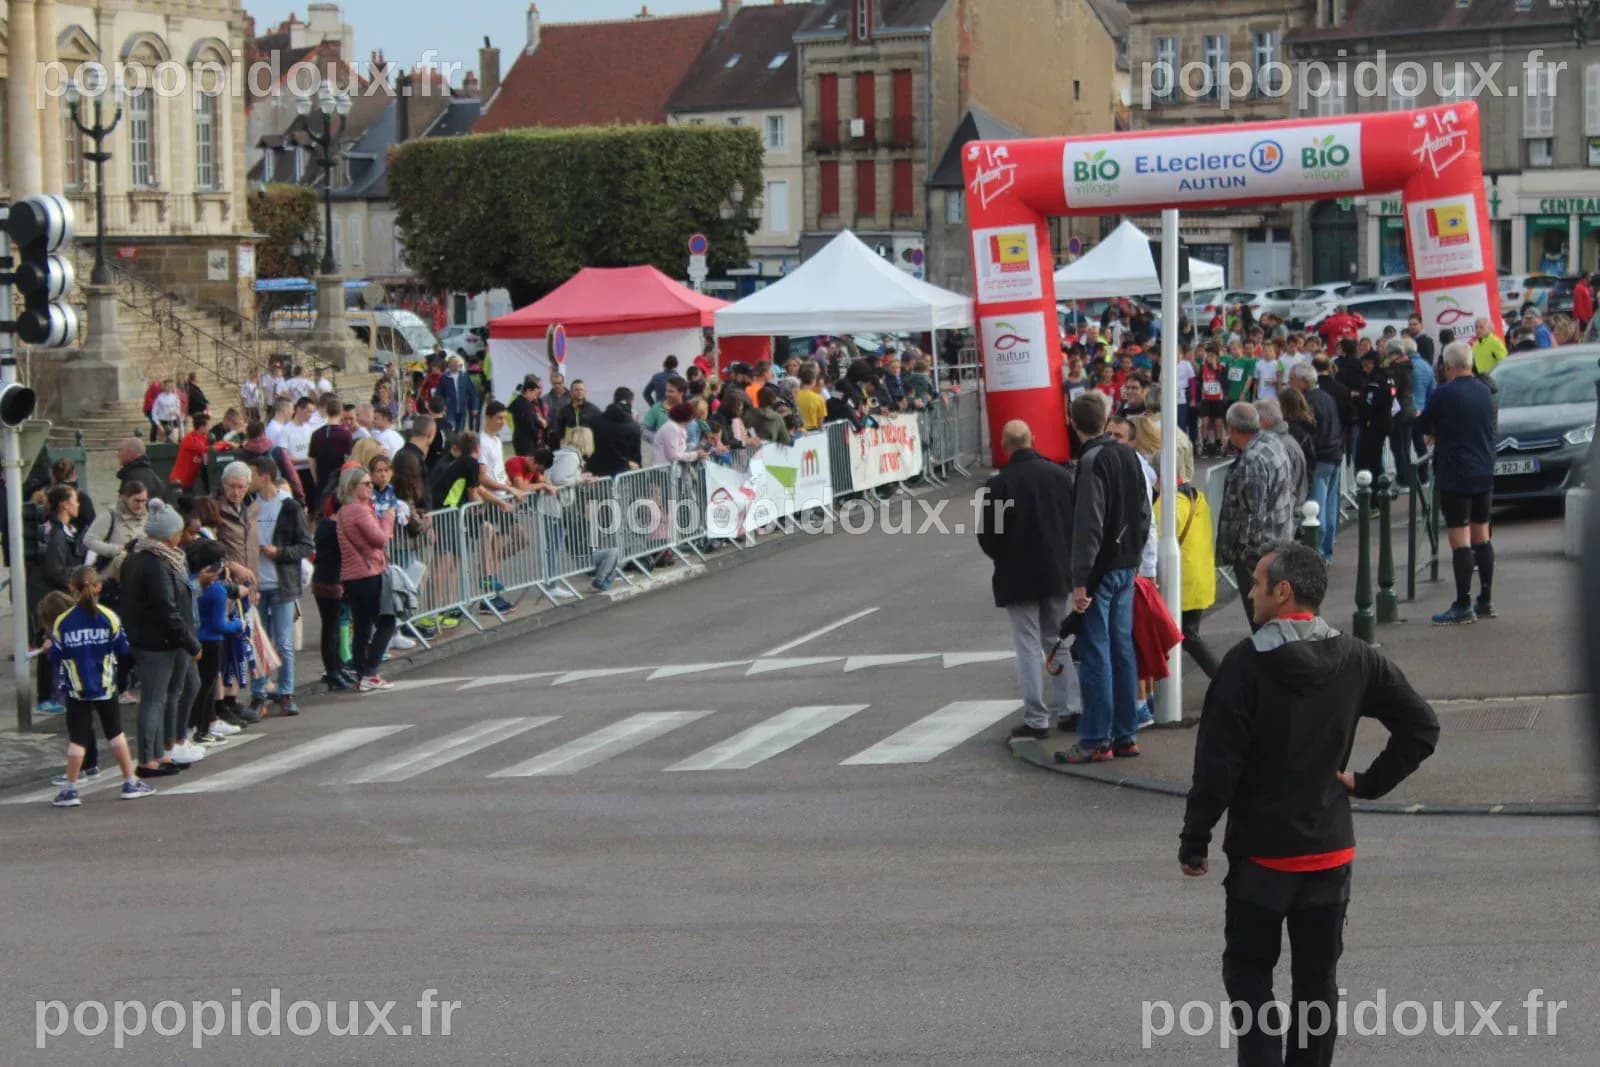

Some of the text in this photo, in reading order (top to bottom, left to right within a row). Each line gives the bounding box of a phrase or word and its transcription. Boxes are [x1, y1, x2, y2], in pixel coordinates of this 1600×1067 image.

[1135, 150, 1246, 174] E.Leclerc
[1303, 166, 1350, 183] village
[1074, 180, 1120, 197] village
[1178, 175, 1247, 192] AUTUN
[996, 350, 1031, 363] autun
[63, 628, 111, 644] AUTUN
